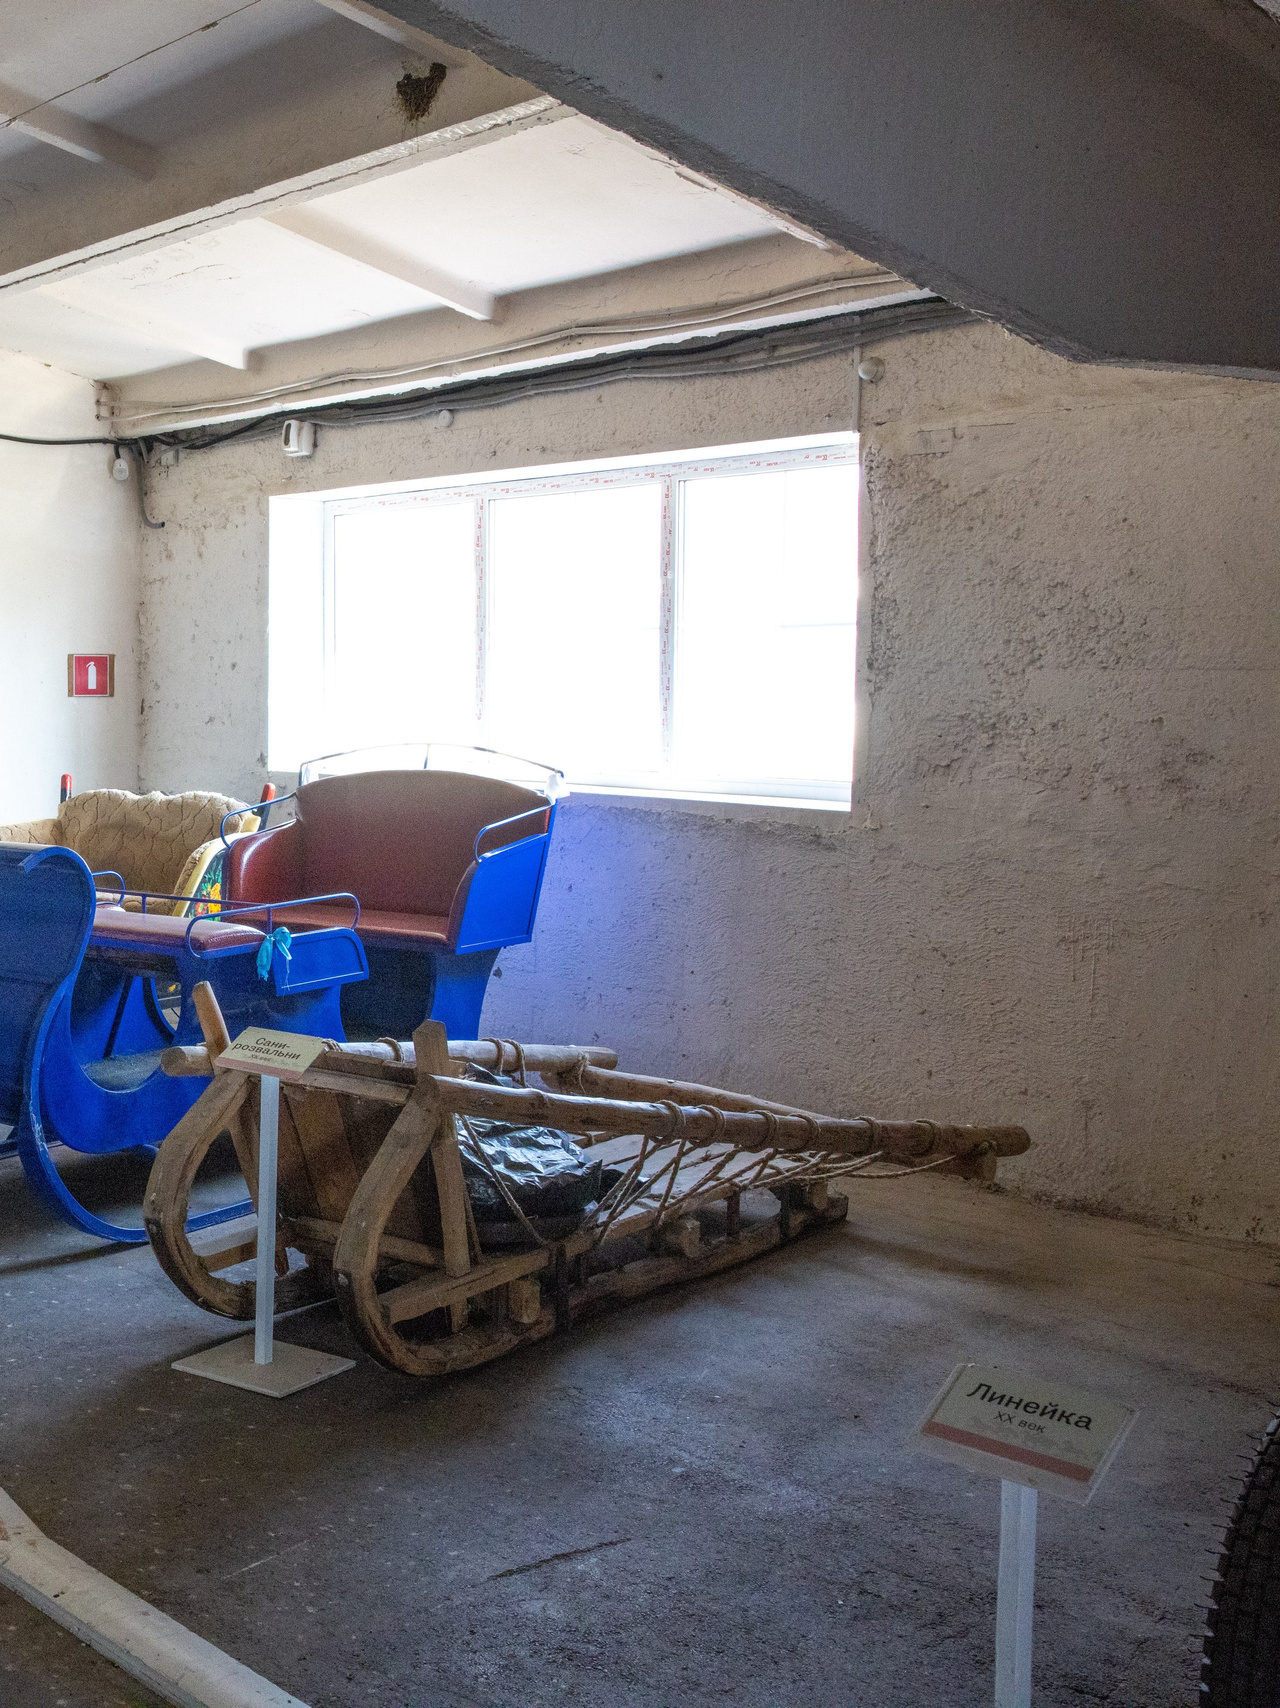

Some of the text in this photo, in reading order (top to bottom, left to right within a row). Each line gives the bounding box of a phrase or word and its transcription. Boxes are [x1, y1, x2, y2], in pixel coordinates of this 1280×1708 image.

[255, 1037, 291, 1050] Сани-
[231, 1043, 301, 1060] розвальни
[966, 1383, 1093, 1431] Линейка
[1018, 1420, 1047, 1433] век
